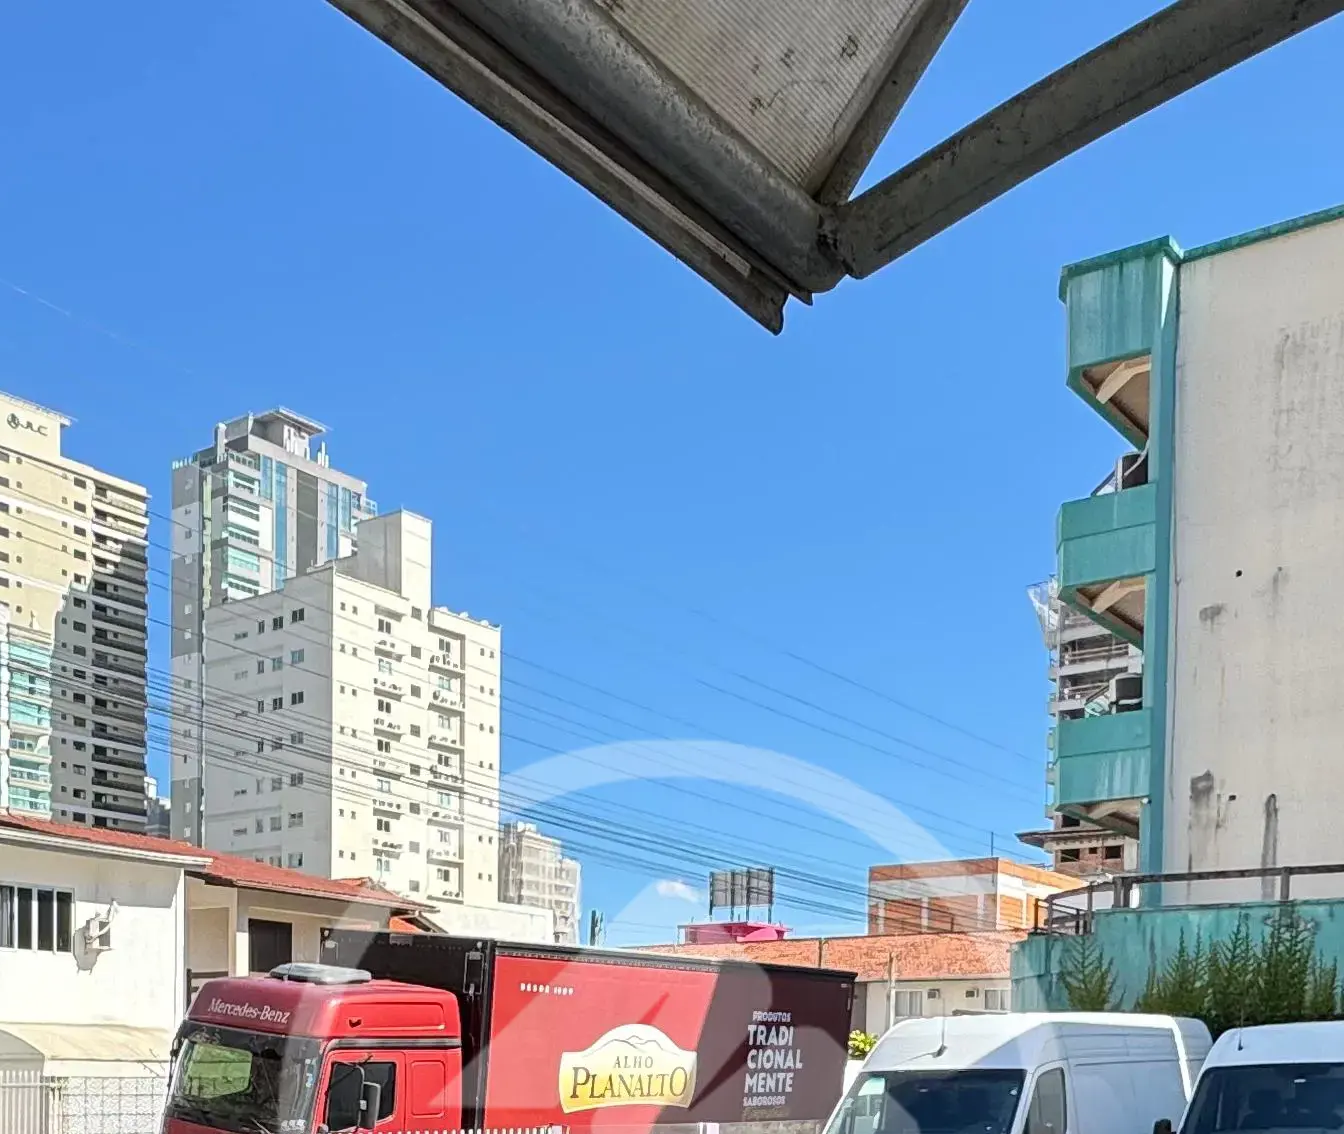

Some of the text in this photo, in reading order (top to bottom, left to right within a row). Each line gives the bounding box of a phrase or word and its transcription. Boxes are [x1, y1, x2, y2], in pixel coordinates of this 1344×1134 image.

[208, 998, 291, 1024] Mercedes-Benz
[752, 1010, 792, 1023] PRODUTOS
[747, 1024, 795, 1046] TRADI
[613, 1055, 654, 1068] ALHO
[746, 1049, 804, 1069] CIONAL
[569, 1066, 688, 1099] PLANALTO
[744, 1072, 794, 1093] MENTE
[742, 1096, 786, 1107] SABOROSOS
